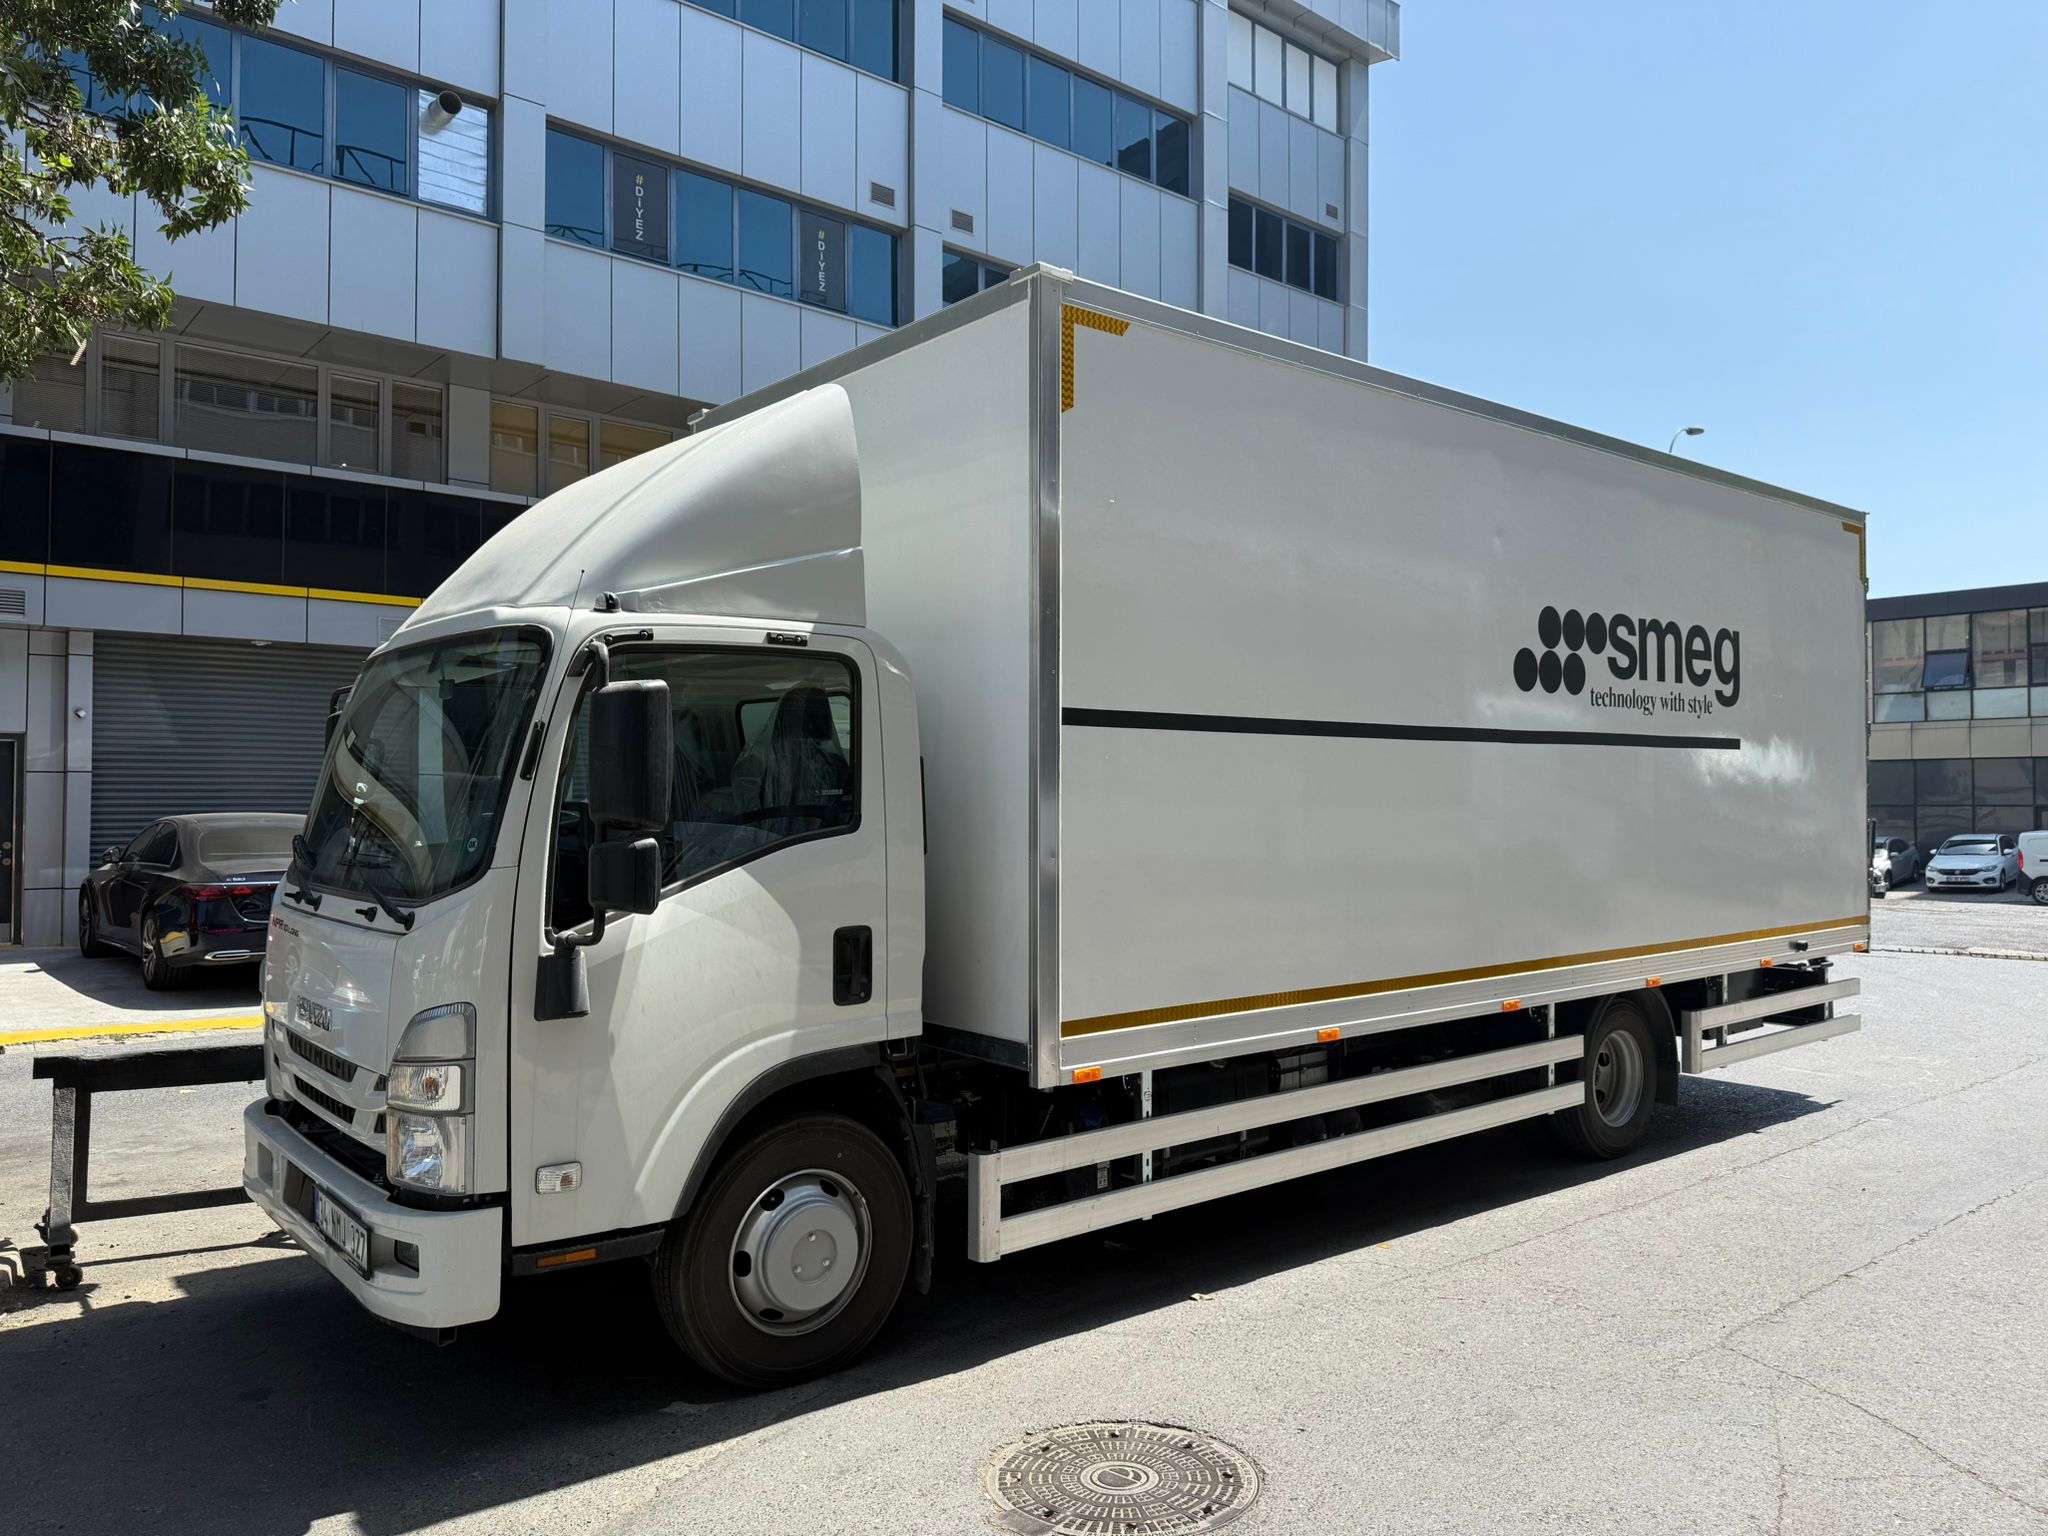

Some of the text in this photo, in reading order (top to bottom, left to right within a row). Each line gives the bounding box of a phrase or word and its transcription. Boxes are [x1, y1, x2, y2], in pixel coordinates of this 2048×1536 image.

[1607, 613, 1740, 708] smeg
[1590, 687, 1713, 719] technology with style
[351, 1223, 366, 1262] 327
